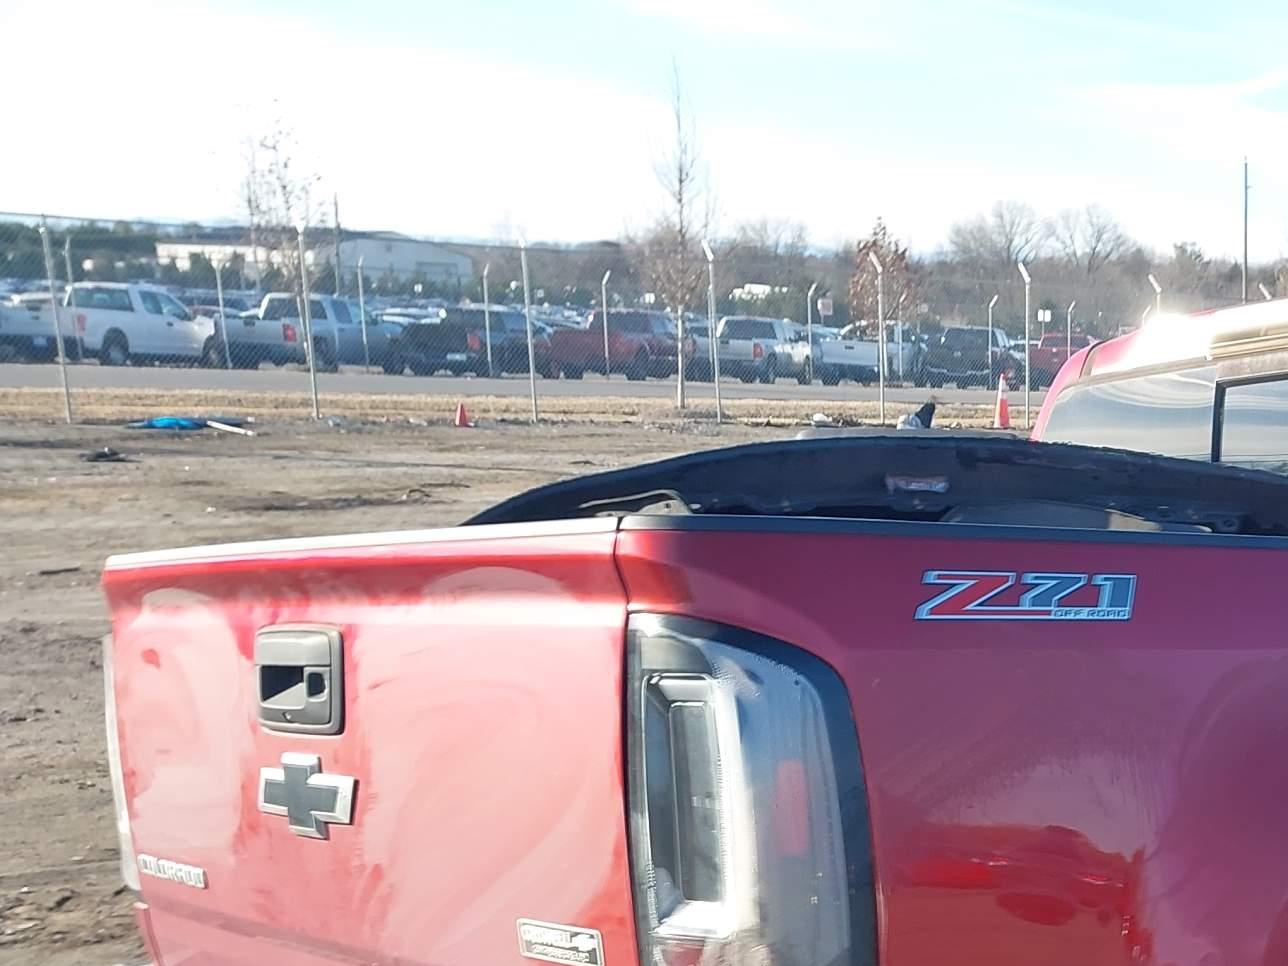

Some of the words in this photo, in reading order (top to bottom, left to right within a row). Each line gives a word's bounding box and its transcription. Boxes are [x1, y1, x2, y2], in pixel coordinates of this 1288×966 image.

[914, 570, 1137, 620] Z71
[1053, 608, 1082, 618] OFF
[1085, 609, 1128, 619] ROAD
